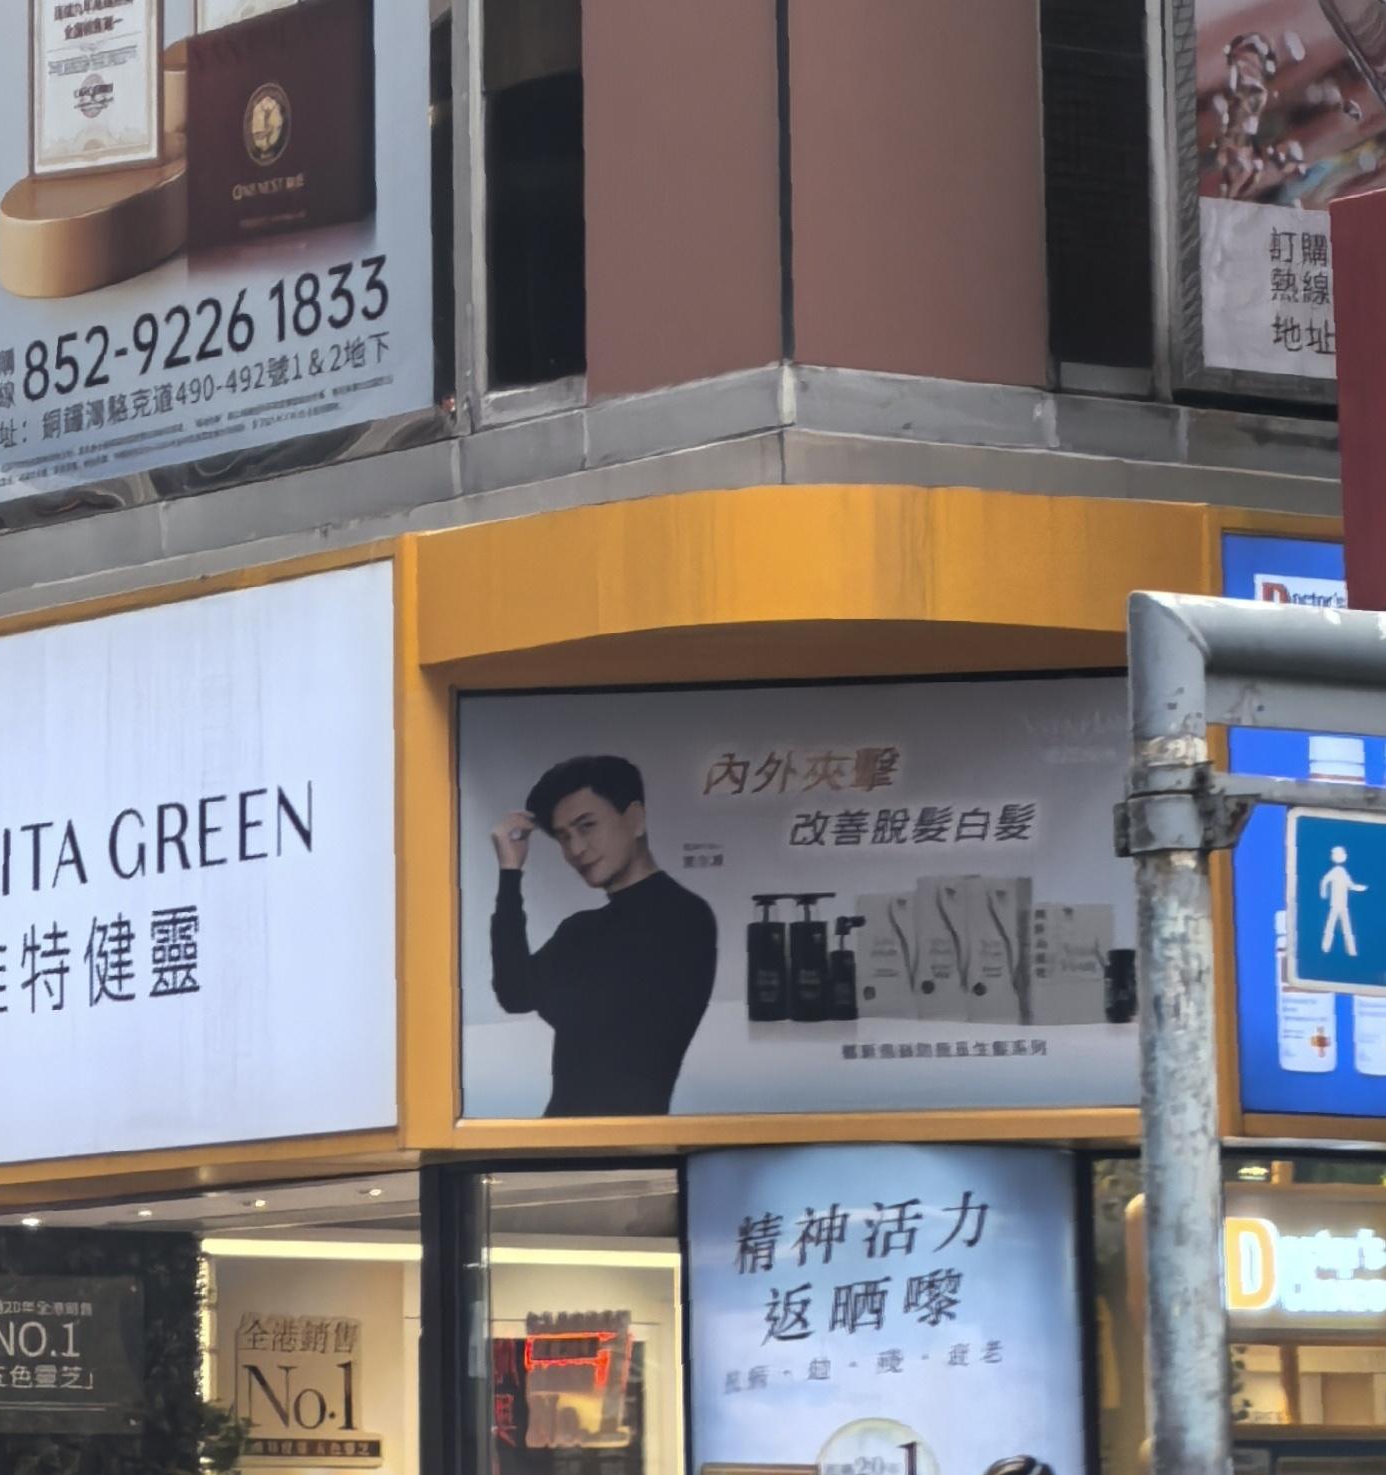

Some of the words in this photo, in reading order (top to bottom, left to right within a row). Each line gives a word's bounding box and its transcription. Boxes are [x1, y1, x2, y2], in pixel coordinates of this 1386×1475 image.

[1269, 228, 1328, 267] 訂購
[1270, 268, 1331, 305] 熱線
[22, 288, 255, 402] 852-9226
[269, 254, 390, 342] 1833
[1273, 316, 1335, 355] 地址
[108, 780, 313, 880] GREEN
[735, 1190, 990, 1275] 精神活力
[243, 1319, 359, 1354] 全港銷售
[761, 1267, 964, 1347] 返晒嚟
[242, 1360, 358, 1430] No.1
